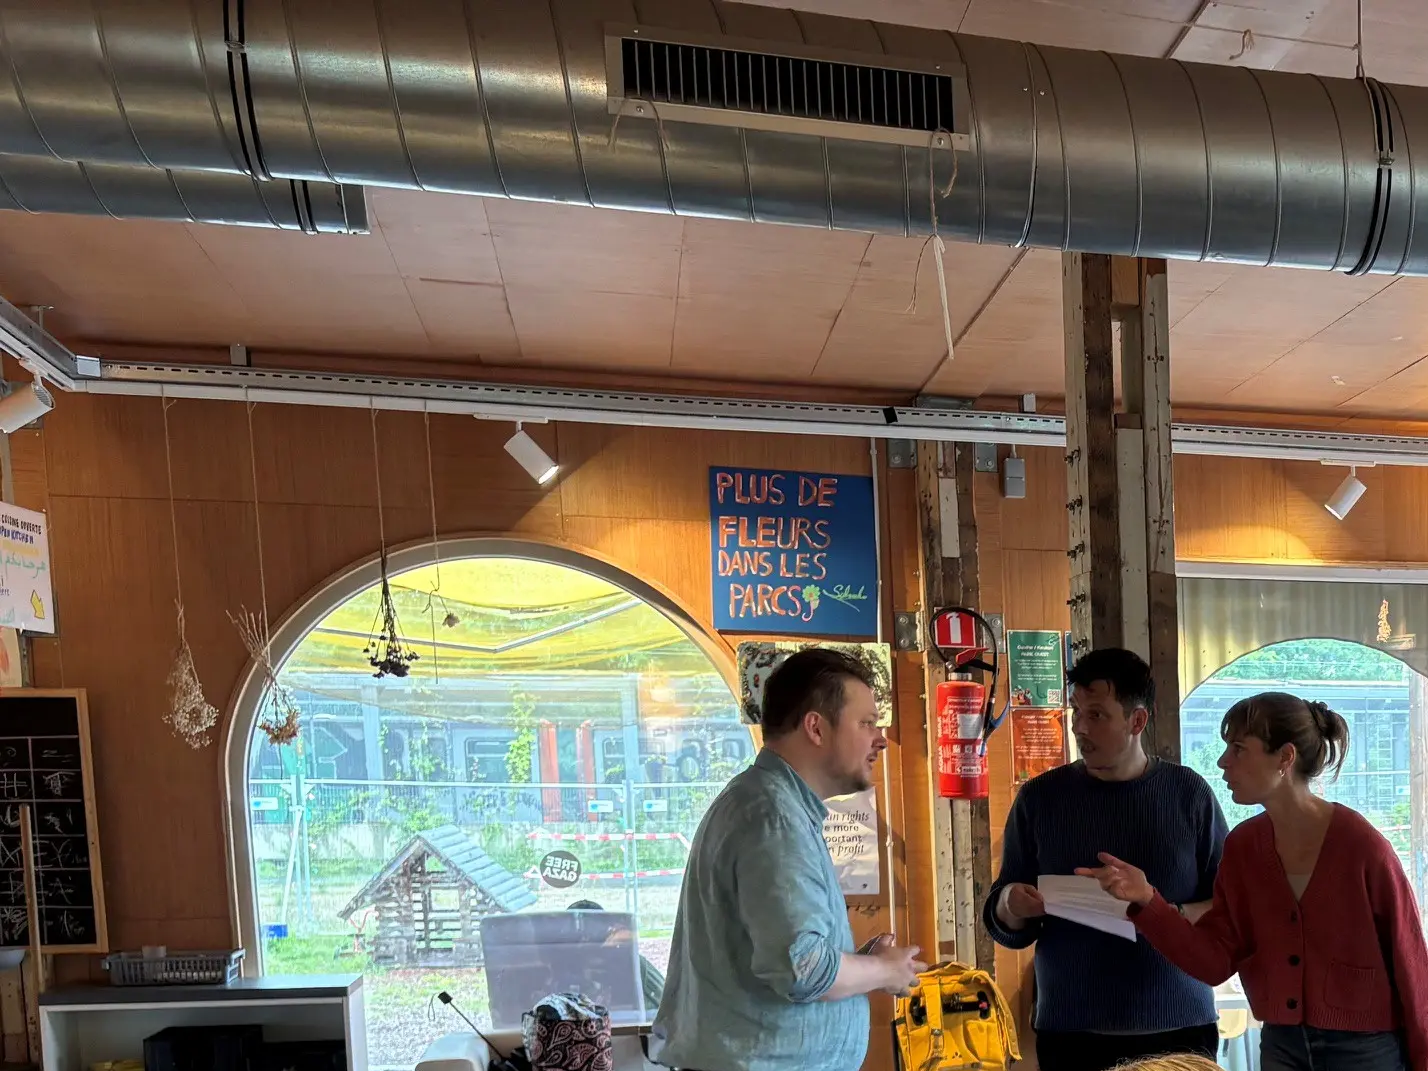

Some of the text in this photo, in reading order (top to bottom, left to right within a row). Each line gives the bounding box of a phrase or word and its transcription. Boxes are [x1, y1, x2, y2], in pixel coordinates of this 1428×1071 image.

[716, 472, 838, 507] PLUS DE
[718, 515, 832, 550] FLEURS
[718, 550, 828, 580] DANS LES
[729, 583, 802, 618] PARCS
[834, 825, 859, 833] more
[841, 810, 870, 824] rights
[837, 844, 865, 857] profit
